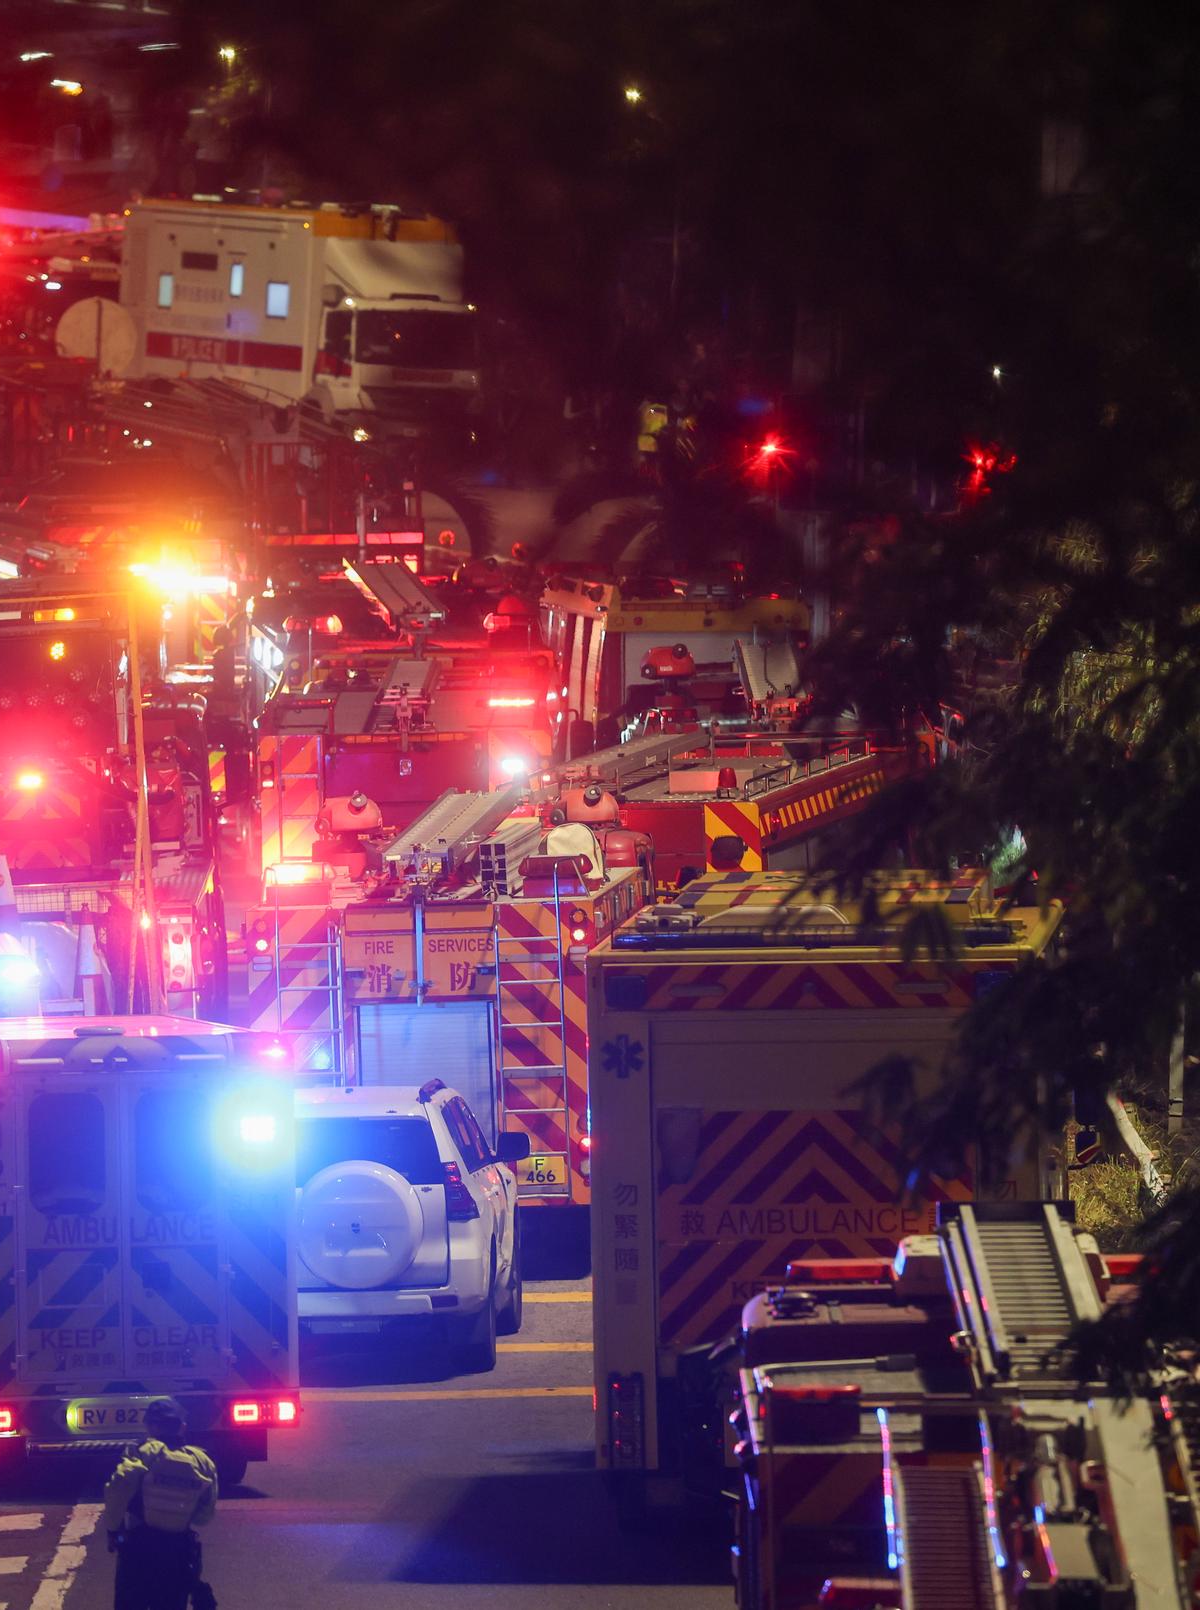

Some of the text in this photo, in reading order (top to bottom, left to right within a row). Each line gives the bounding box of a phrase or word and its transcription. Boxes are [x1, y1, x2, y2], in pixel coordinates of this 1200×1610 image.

[364, 938, 494, 955] FIRE SERVICES
[535, 1158, 545, 1171] F
[526, 1170, 557, 1183] 466
[716, 1208, 919, 1234] AMBULANCE
[41, 1327, 218, 1350] KEEP CLEAR
[83, 1409, 108, 1425] RV
